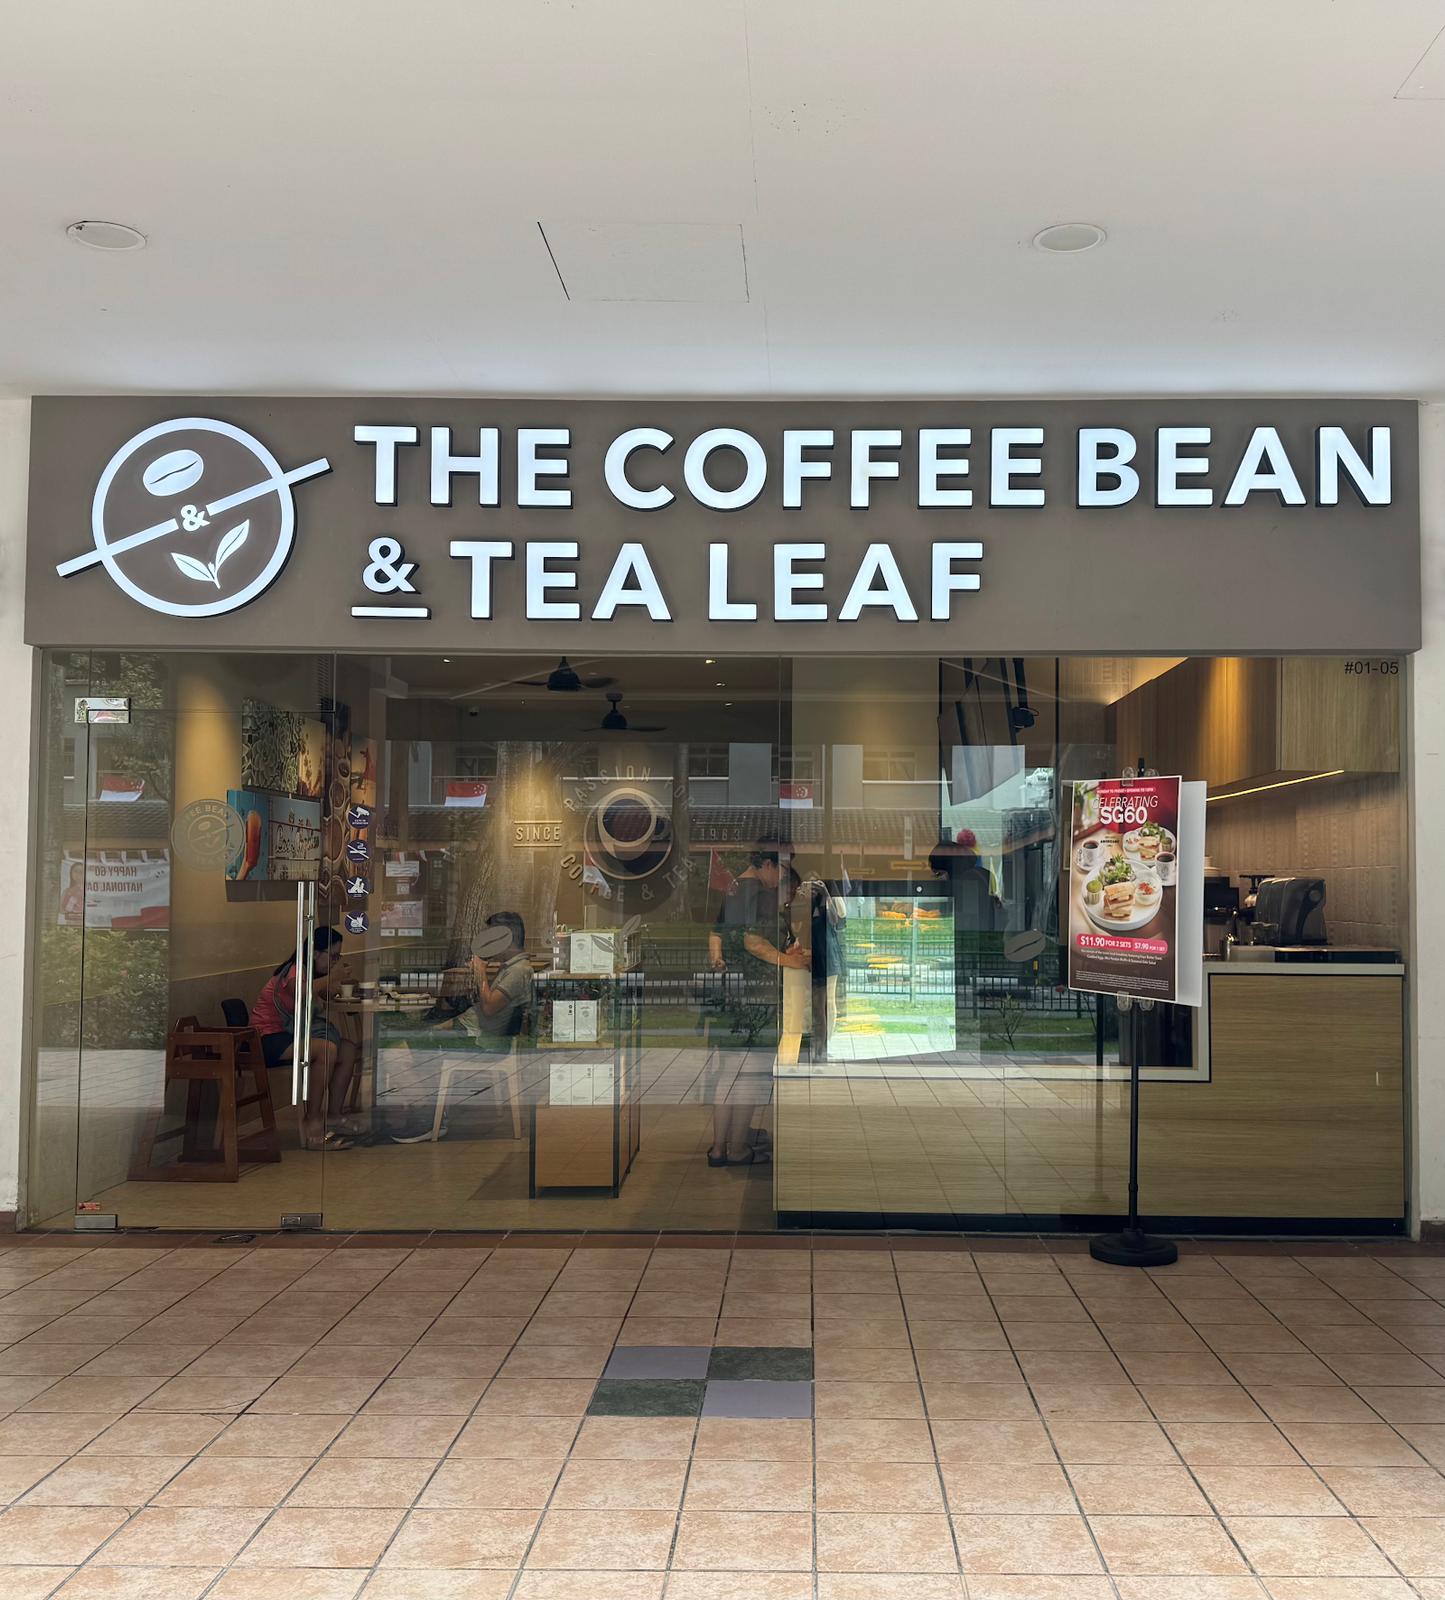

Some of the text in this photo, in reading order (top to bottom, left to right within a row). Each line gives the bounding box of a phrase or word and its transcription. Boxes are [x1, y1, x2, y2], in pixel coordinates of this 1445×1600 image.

[353, 425, 1392, 510] THE COFFEE BEAN
[180, 504, 210, 531] &
[361, 537, 984, 622] & TEA LEAF
[1343, 661, 1399, 676] #01-05
[563, 765, 652, 812] PASSION
[1092, 795, 1159, 809] CELEBRATING
[1100, 806, 1148, 825] SG60
[515, 827, 561, 842] SINCE
[700, 828, 741, 841] 1963
[641, 883, 655, 901] &
[662, 857, 697, 889] TEA
[1080, 935, 1105, 947] $11.90
[1134, 942, 1149, 950] $7.90
